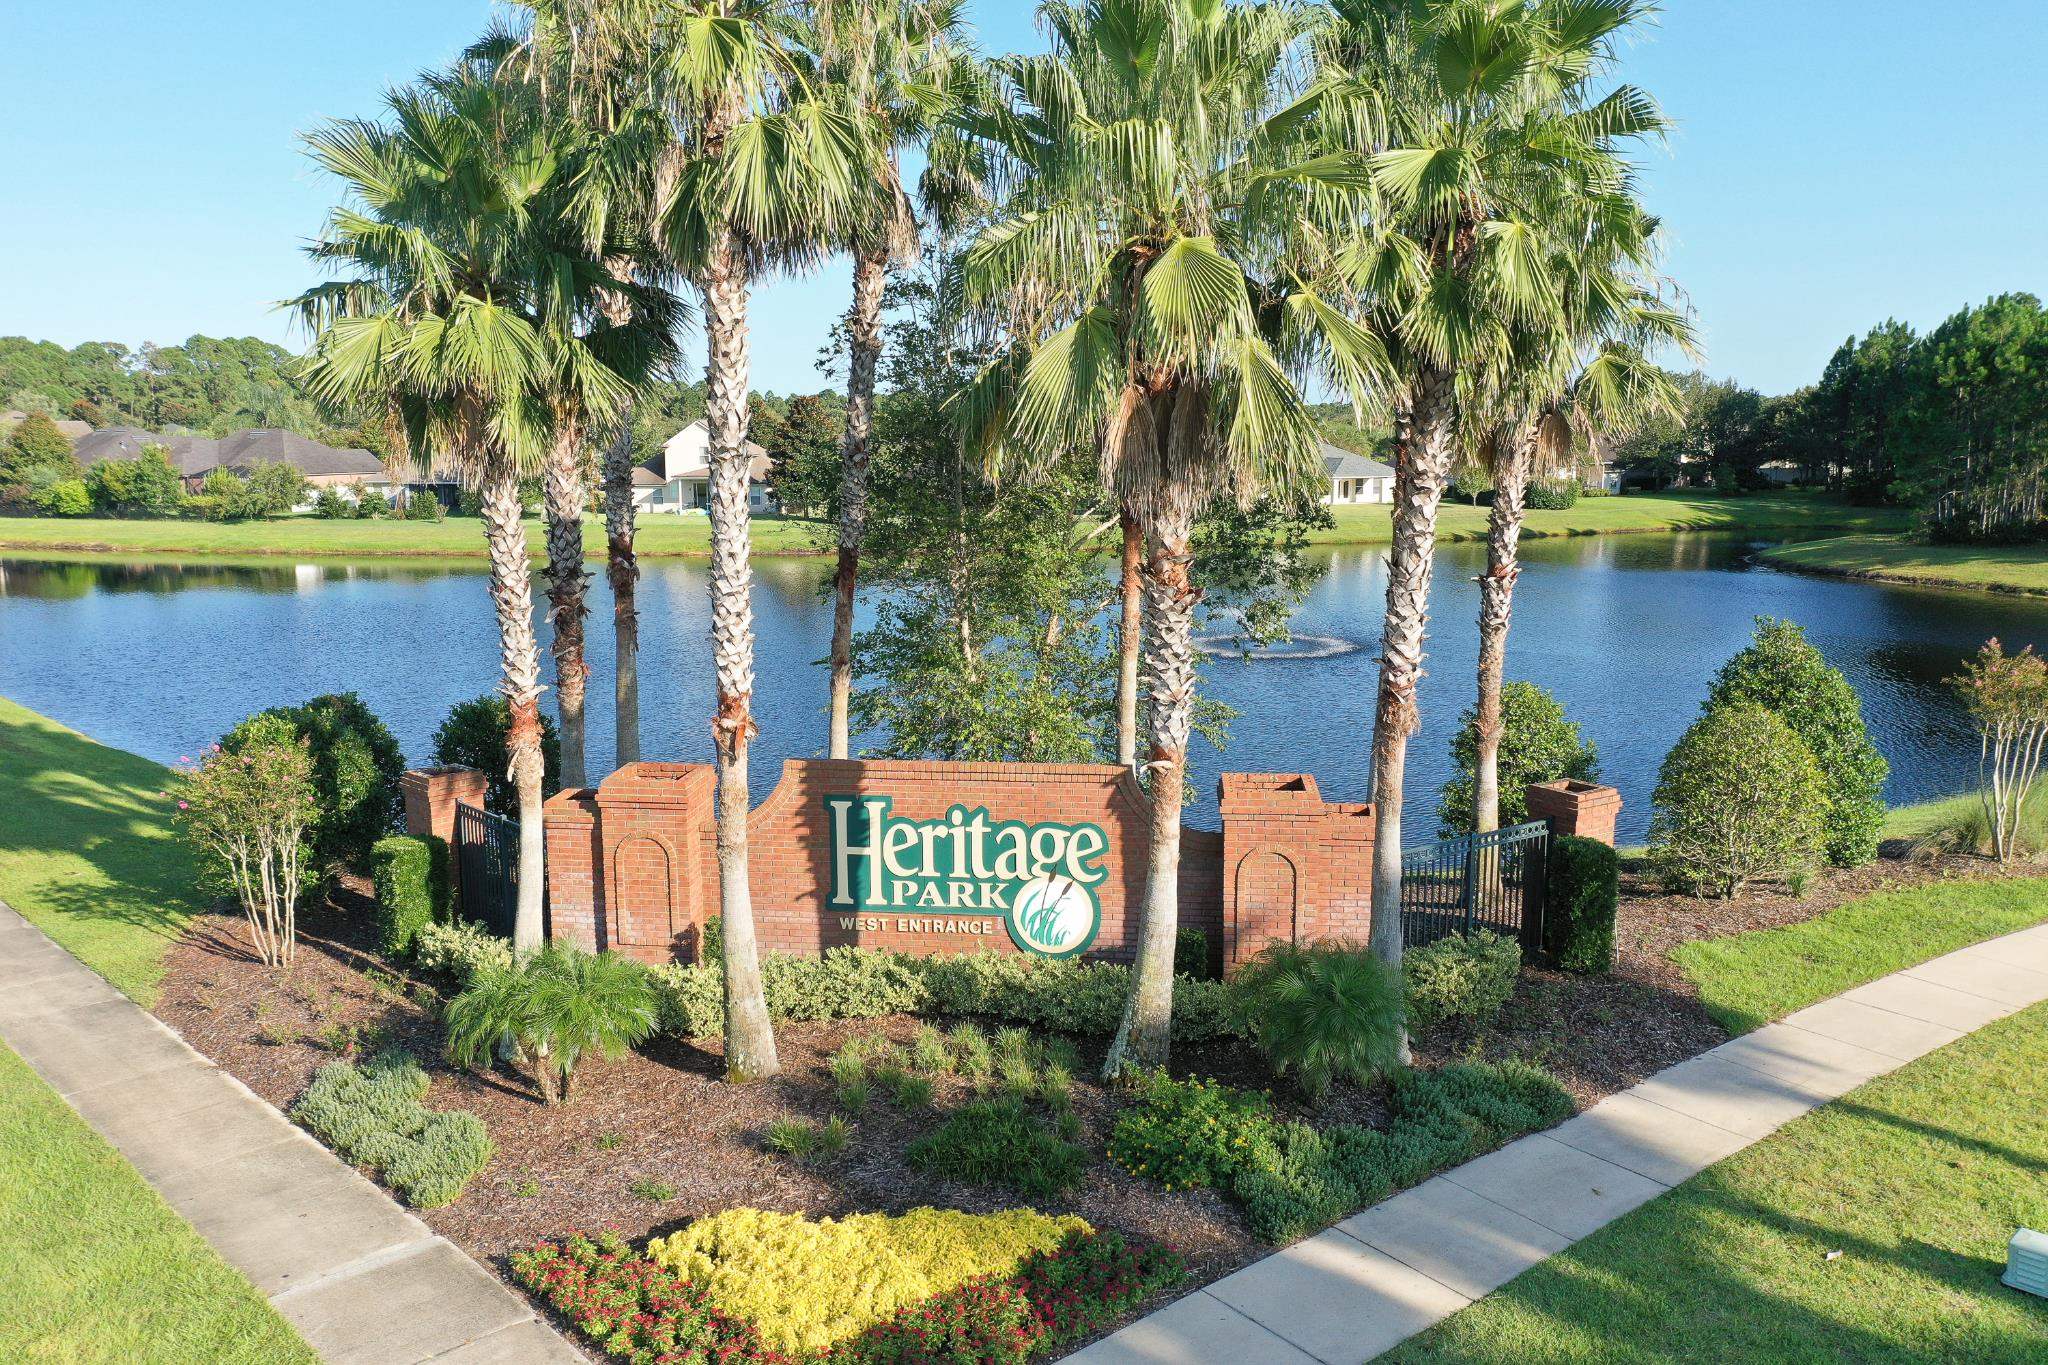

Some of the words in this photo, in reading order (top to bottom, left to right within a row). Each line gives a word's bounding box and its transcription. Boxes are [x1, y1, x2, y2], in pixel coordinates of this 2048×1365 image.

[830, 800, 1104, 906] Heritage
[891, 880, 1011, 909] PARK
[840, 917, 889, 932] WEST
[897, 919, 993, 935] ENTRANCE
